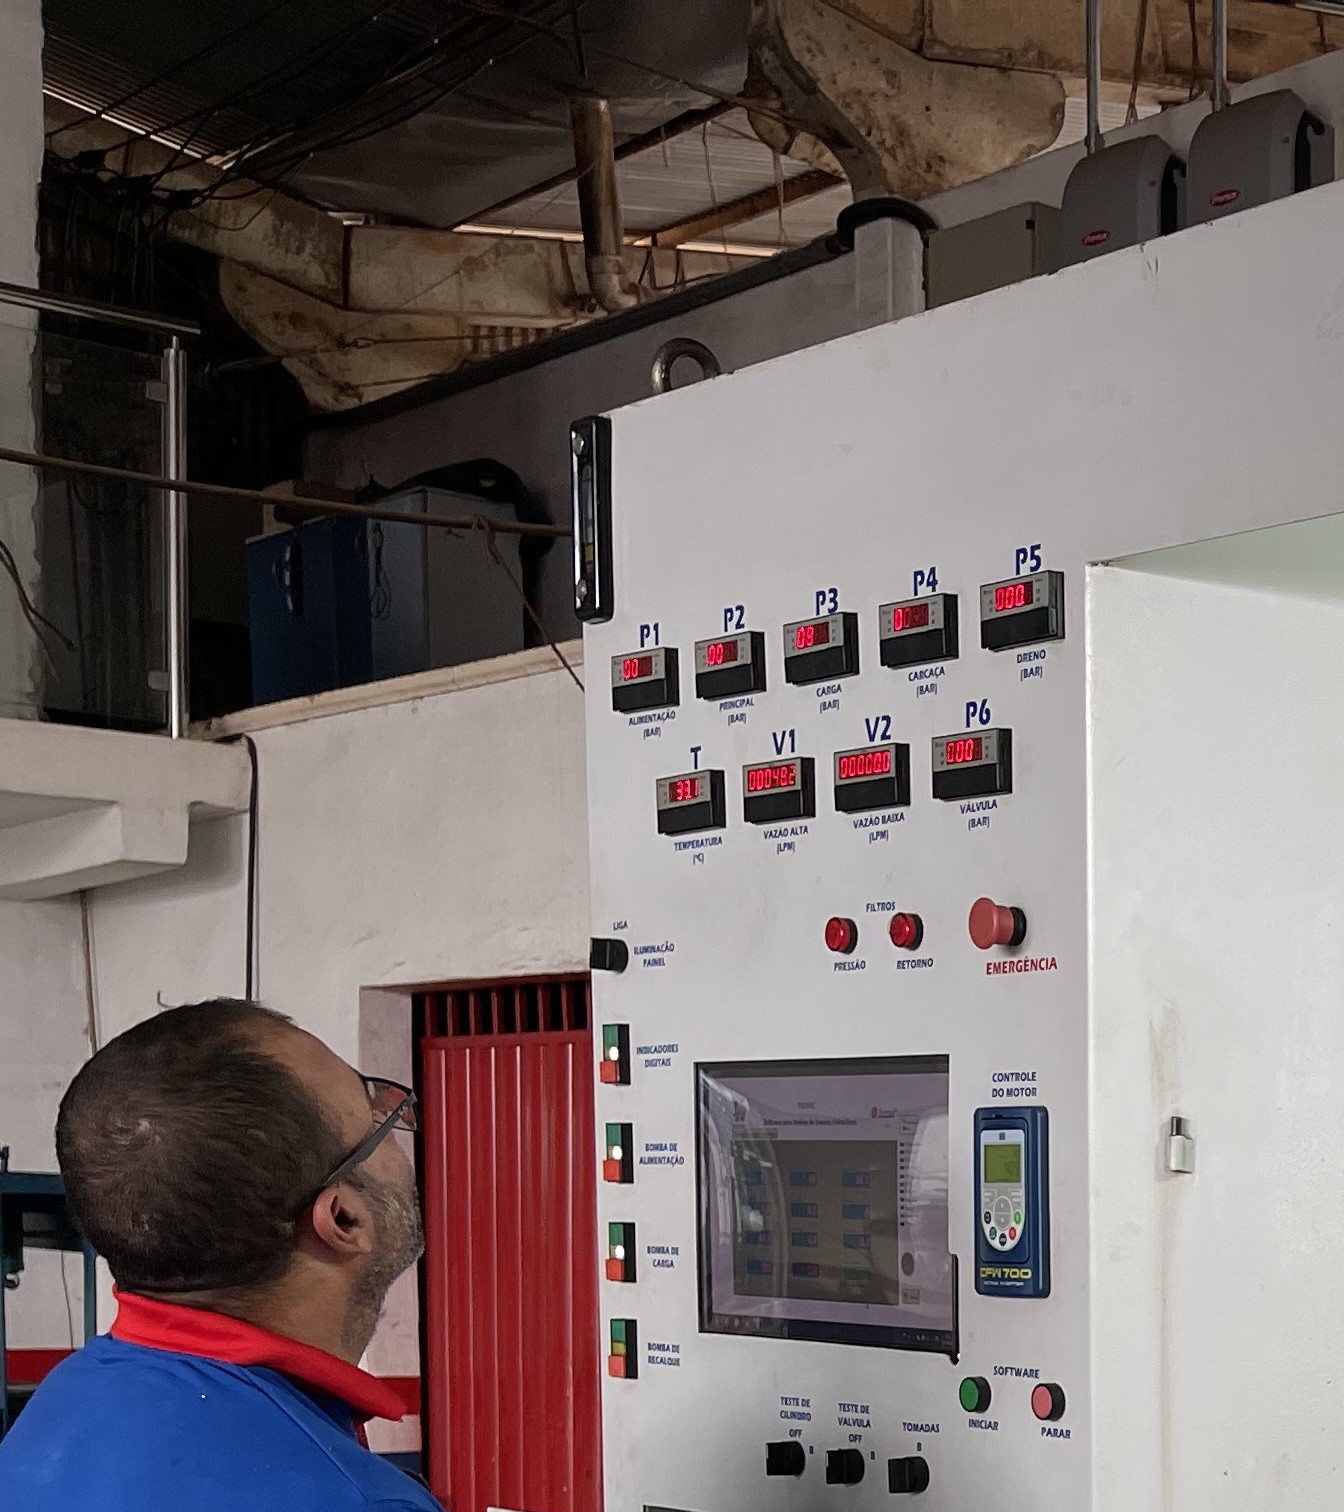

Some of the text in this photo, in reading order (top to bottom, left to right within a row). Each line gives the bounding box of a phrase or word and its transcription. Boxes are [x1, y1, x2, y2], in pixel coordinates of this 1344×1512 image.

[1015, 544, 1042, 575] P5
[913, 567, 938, 596] P4
[815, 588, 839, 616] P3
[723, 605, 745, 632] P2
[640, 623, 659, 648] P1
[1016, 650, 1046, 664] DRENO
[908, 666, 945, 682] CARCAÇA
[816, 684, 842, 698] CARGA
[966, 698, 991, 728] P6
[865, 714, 892, 743] V2
[772, 729, 796, 756] V1
[690, 746, 702, 770] T
[960, 800, 998, 814] VÁLVULA
[853, 816, 880, 829] VAZÃO
[763, 825, 809, 840] VAZÃO ALTA
[674, 836, 723, 851] TEMPERATURA
[866, 901, 896, 913] FILTROS
[613, 920, 628, 931] LIGA
[833, 959, 867, 972] PRESSÃO
[896, 958, 934, 970] RETORNO
[986, 955, 1058, 976] EMERGÊNCIA
[992, 1072, 1036, 1083] CONTROLE
[992, 1088, 1037, 1097] DO MOTOR
[993, 1366, 1040, 1380] SOFTWARE
[780, 1397, 799, 1407] TESTE
[838, 1403, 870, 1414] TESTE DE
[902, 1422, 940, 1433] TOMADAS
[968, 1420, 998, 1431] INICIAR
[1041, 1427, 1071, 1439] PARAR
